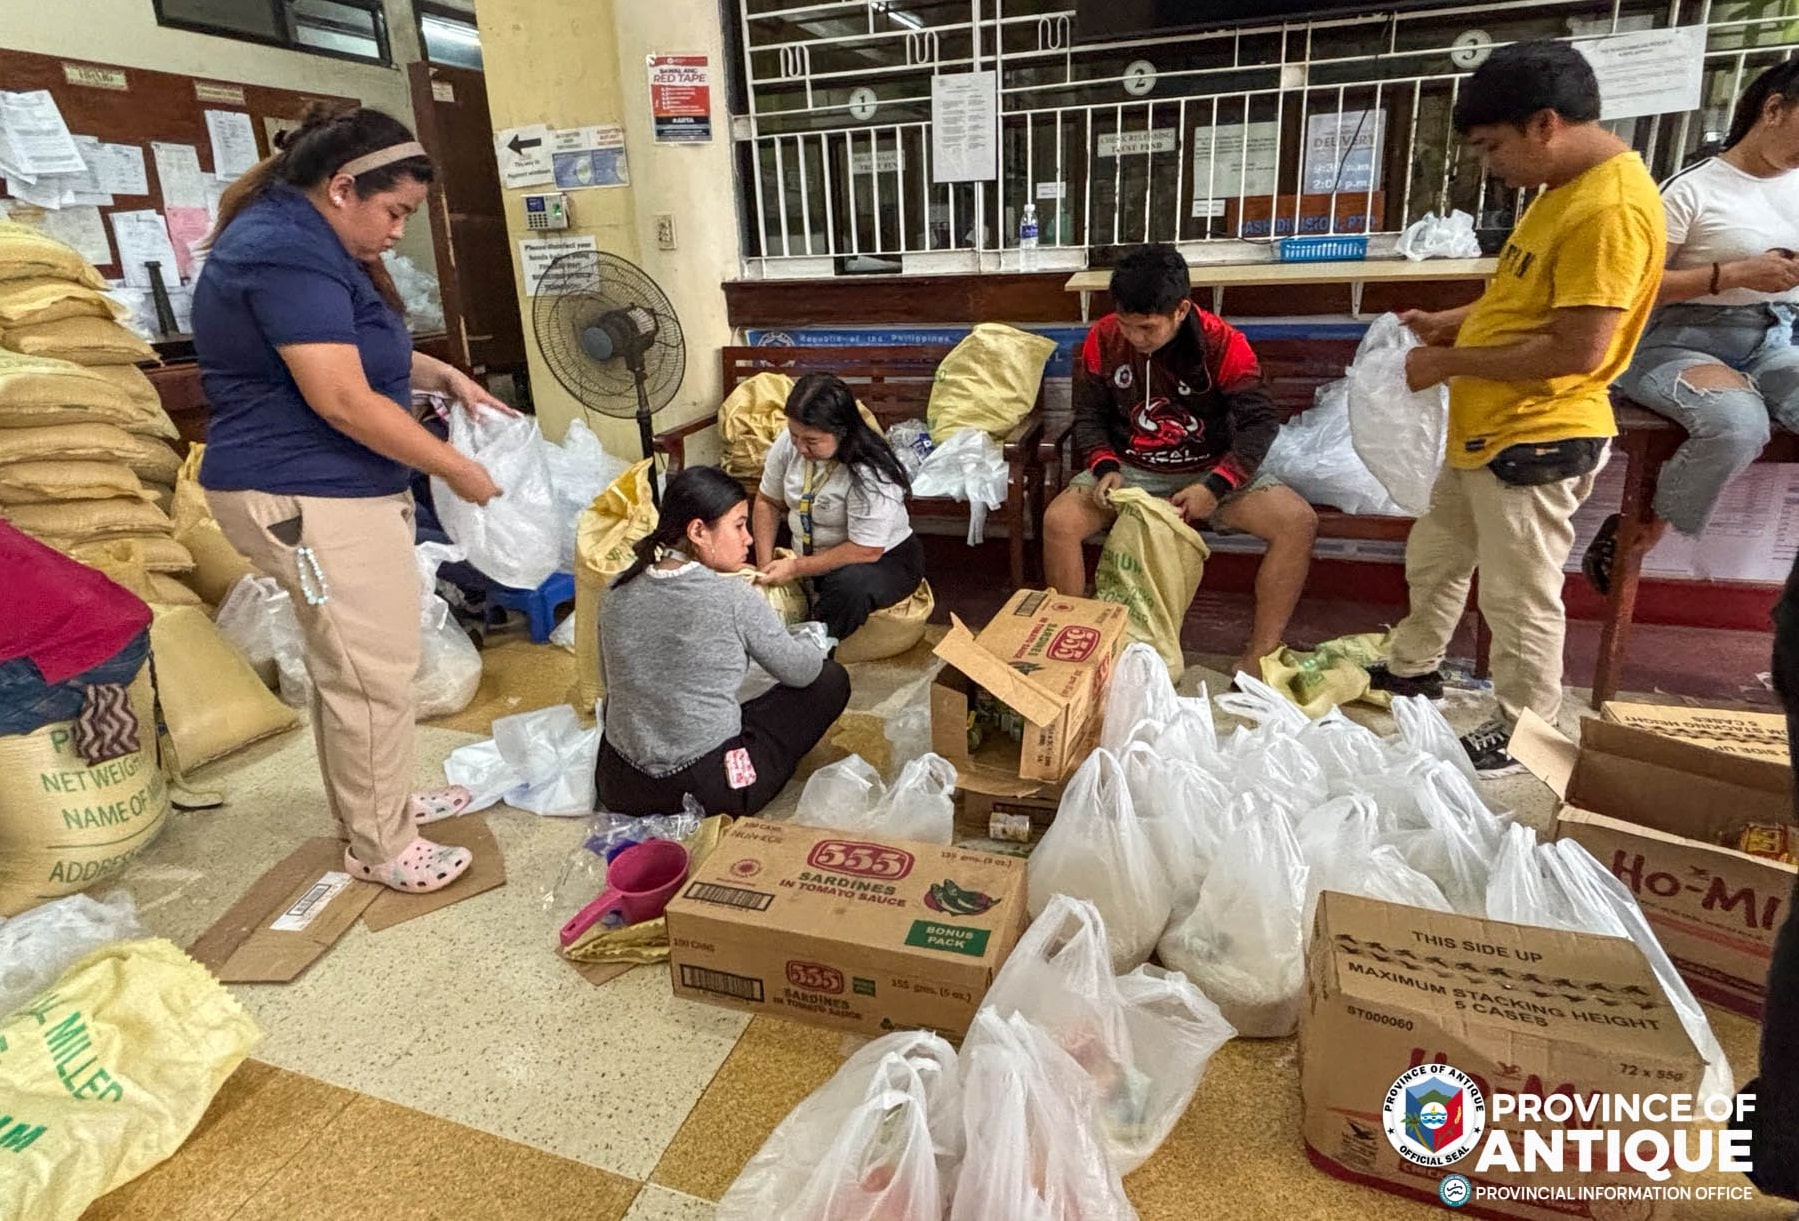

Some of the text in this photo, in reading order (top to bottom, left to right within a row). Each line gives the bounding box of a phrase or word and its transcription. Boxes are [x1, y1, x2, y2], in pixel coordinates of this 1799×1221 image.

[1461, 38, 1478, 61] 3
[653, 74, 707, 84] RED TAPE
[1134, 68, 1146, 88] 2
[858, 95, 867, 113] 1
[1053, 627, 1096, 660] 555
[1624, 715, 1680, 729] HEIGHT
[1682, 720, 1764, 735] STACKING
[40, 769, 87, 793] NET
[61, 799, 130, 831] NAME
[129, 790, 149, 816] OF
[819, 843, 908, 875] 555
[778, 878, 907, 908] IN TOMATO SAUCE
[798, 872, 897, 896] SARDINES
[925, 926, 975, 941] BONUS
[927, 936, 967, 949] PACK
[1412, 930, 1543, 964] THIS SIDE UP
[791, 962, 841, 992] 555
[784, 988, 850, 1010] SARDINES
[1348, 961, 1661, 1033] MAXIMUM STACKING HEIGHT
[1346, 1005, 1415, 1032] ST000060
[1454, 999, 1550, 1029] 5 CASES
[1619, 1062, 1684, 1083] 72 x 55g
